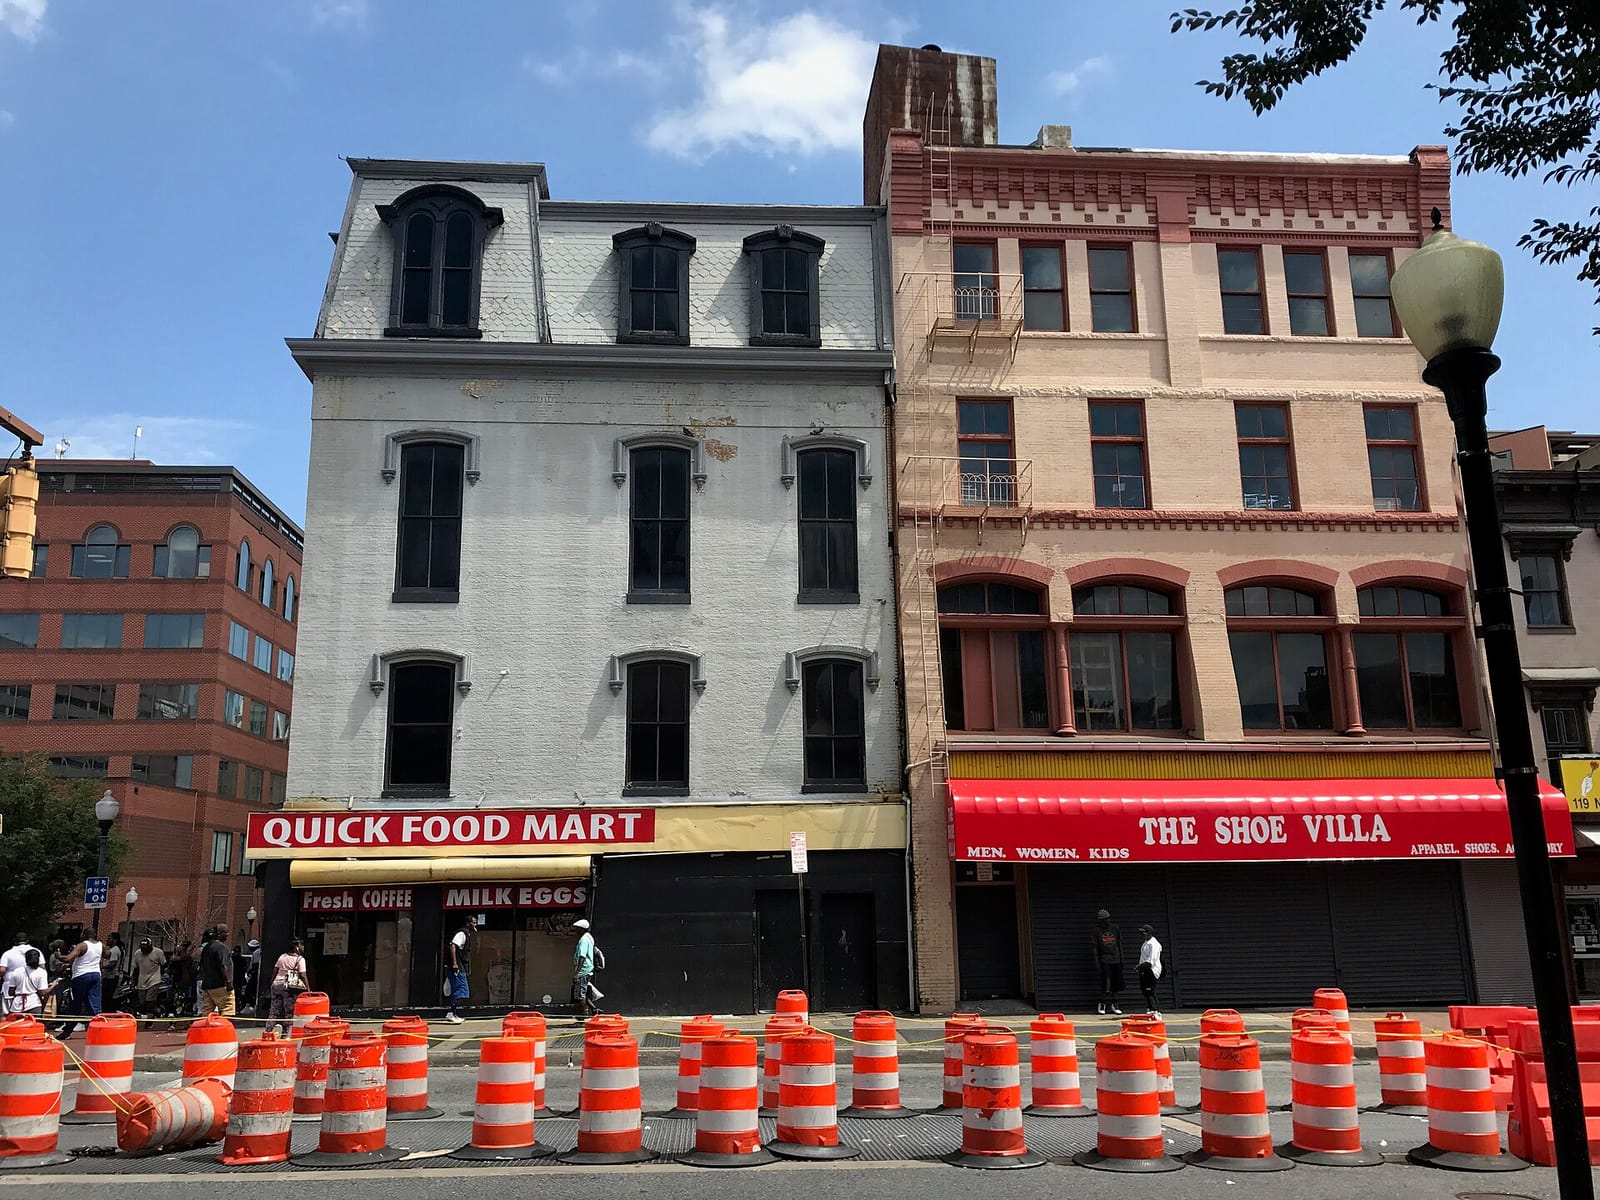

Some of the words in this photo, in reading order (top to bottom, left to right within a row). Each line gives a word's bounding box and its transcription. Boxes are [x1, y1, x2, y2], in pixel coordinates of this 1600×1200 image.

[1573, 798, 1590, 809] 119
[263, 816, 391, 848] QUICK
[401, 815, 511, 843] FOOD
[522, 813, 642, 841] MART
[1139, 817, 1199, 845] THE
[1215, 816, 1288, 845] SHOE
[1303, 814, 1392, 842] VILLA
[967, 846, 1007, 858] MEN.
[1016, 847, 1080, 859] WOMEN.
[1089, 848, 1130, 859] KIDS
[1411, 843, 1460, 855] APPAREL.
[1465, 843, 1500, 854] SHOES.
[303, 891, 354, 909] Fresh
[362, 889, 413, 909] COFFEE
[446, 887, 512, 906] MILK
[519, 886, 587, 905] EGGS
